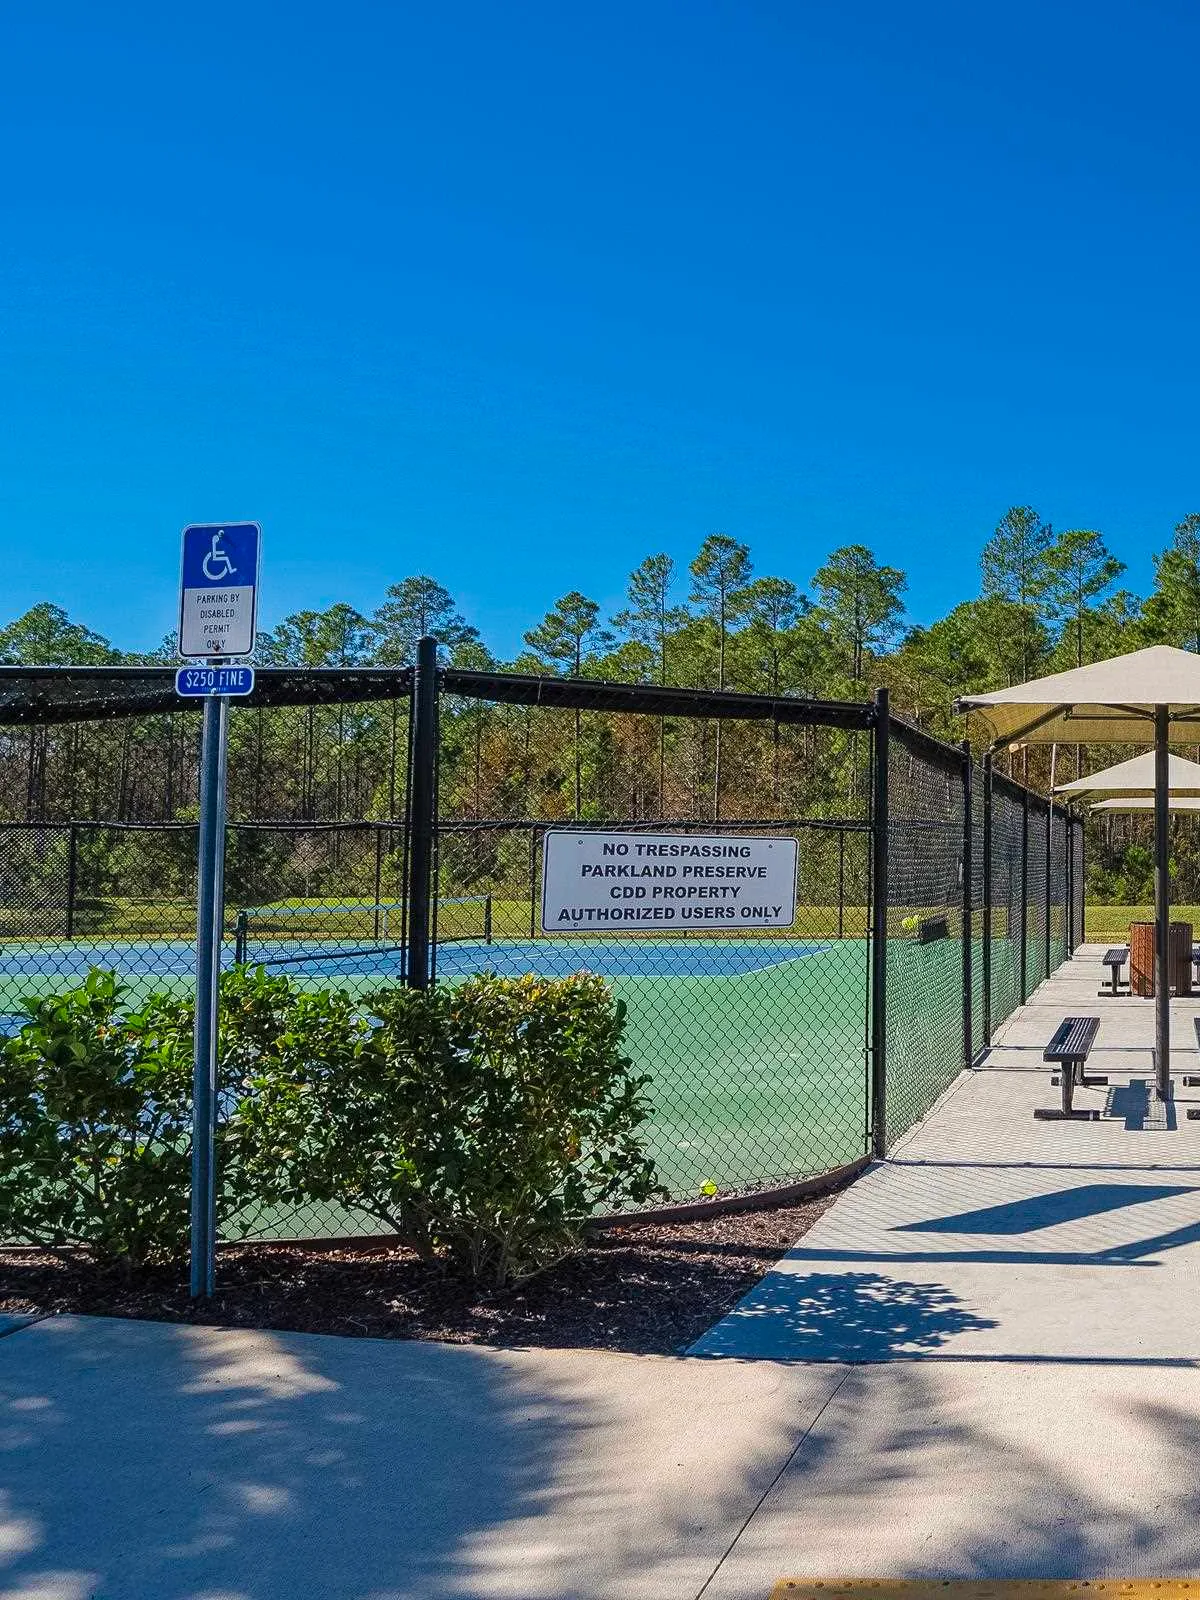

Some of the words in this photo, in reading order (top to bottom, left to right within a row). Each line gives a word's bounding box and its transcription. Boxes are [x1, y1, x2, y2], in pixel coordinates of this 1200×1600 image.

[196, 593, 228, 604] PARKING
[230, 593, 240, 603] BY
[200, 608, 235, 619] DISABLED
[203, 624, 230, 634] PERMIT
[186, 671, 214, 688] $250
[219, 670, 245, 686] FINE
[602, 843, 629, 857] NO
[635, 843, 751, 858] TRESPASSING
[581, 864, 677, 878] PARKLAND
[682, 866, 768, 879] PRESERVE
[609, 886, 646, 899] CDD
[652, 886, 741, 899] PROPERTY
[557, 907, 676, 922] AUTHORIZED
[681, 906, 736, 920] USERS
[740, 905, 783, 919] ONLY
